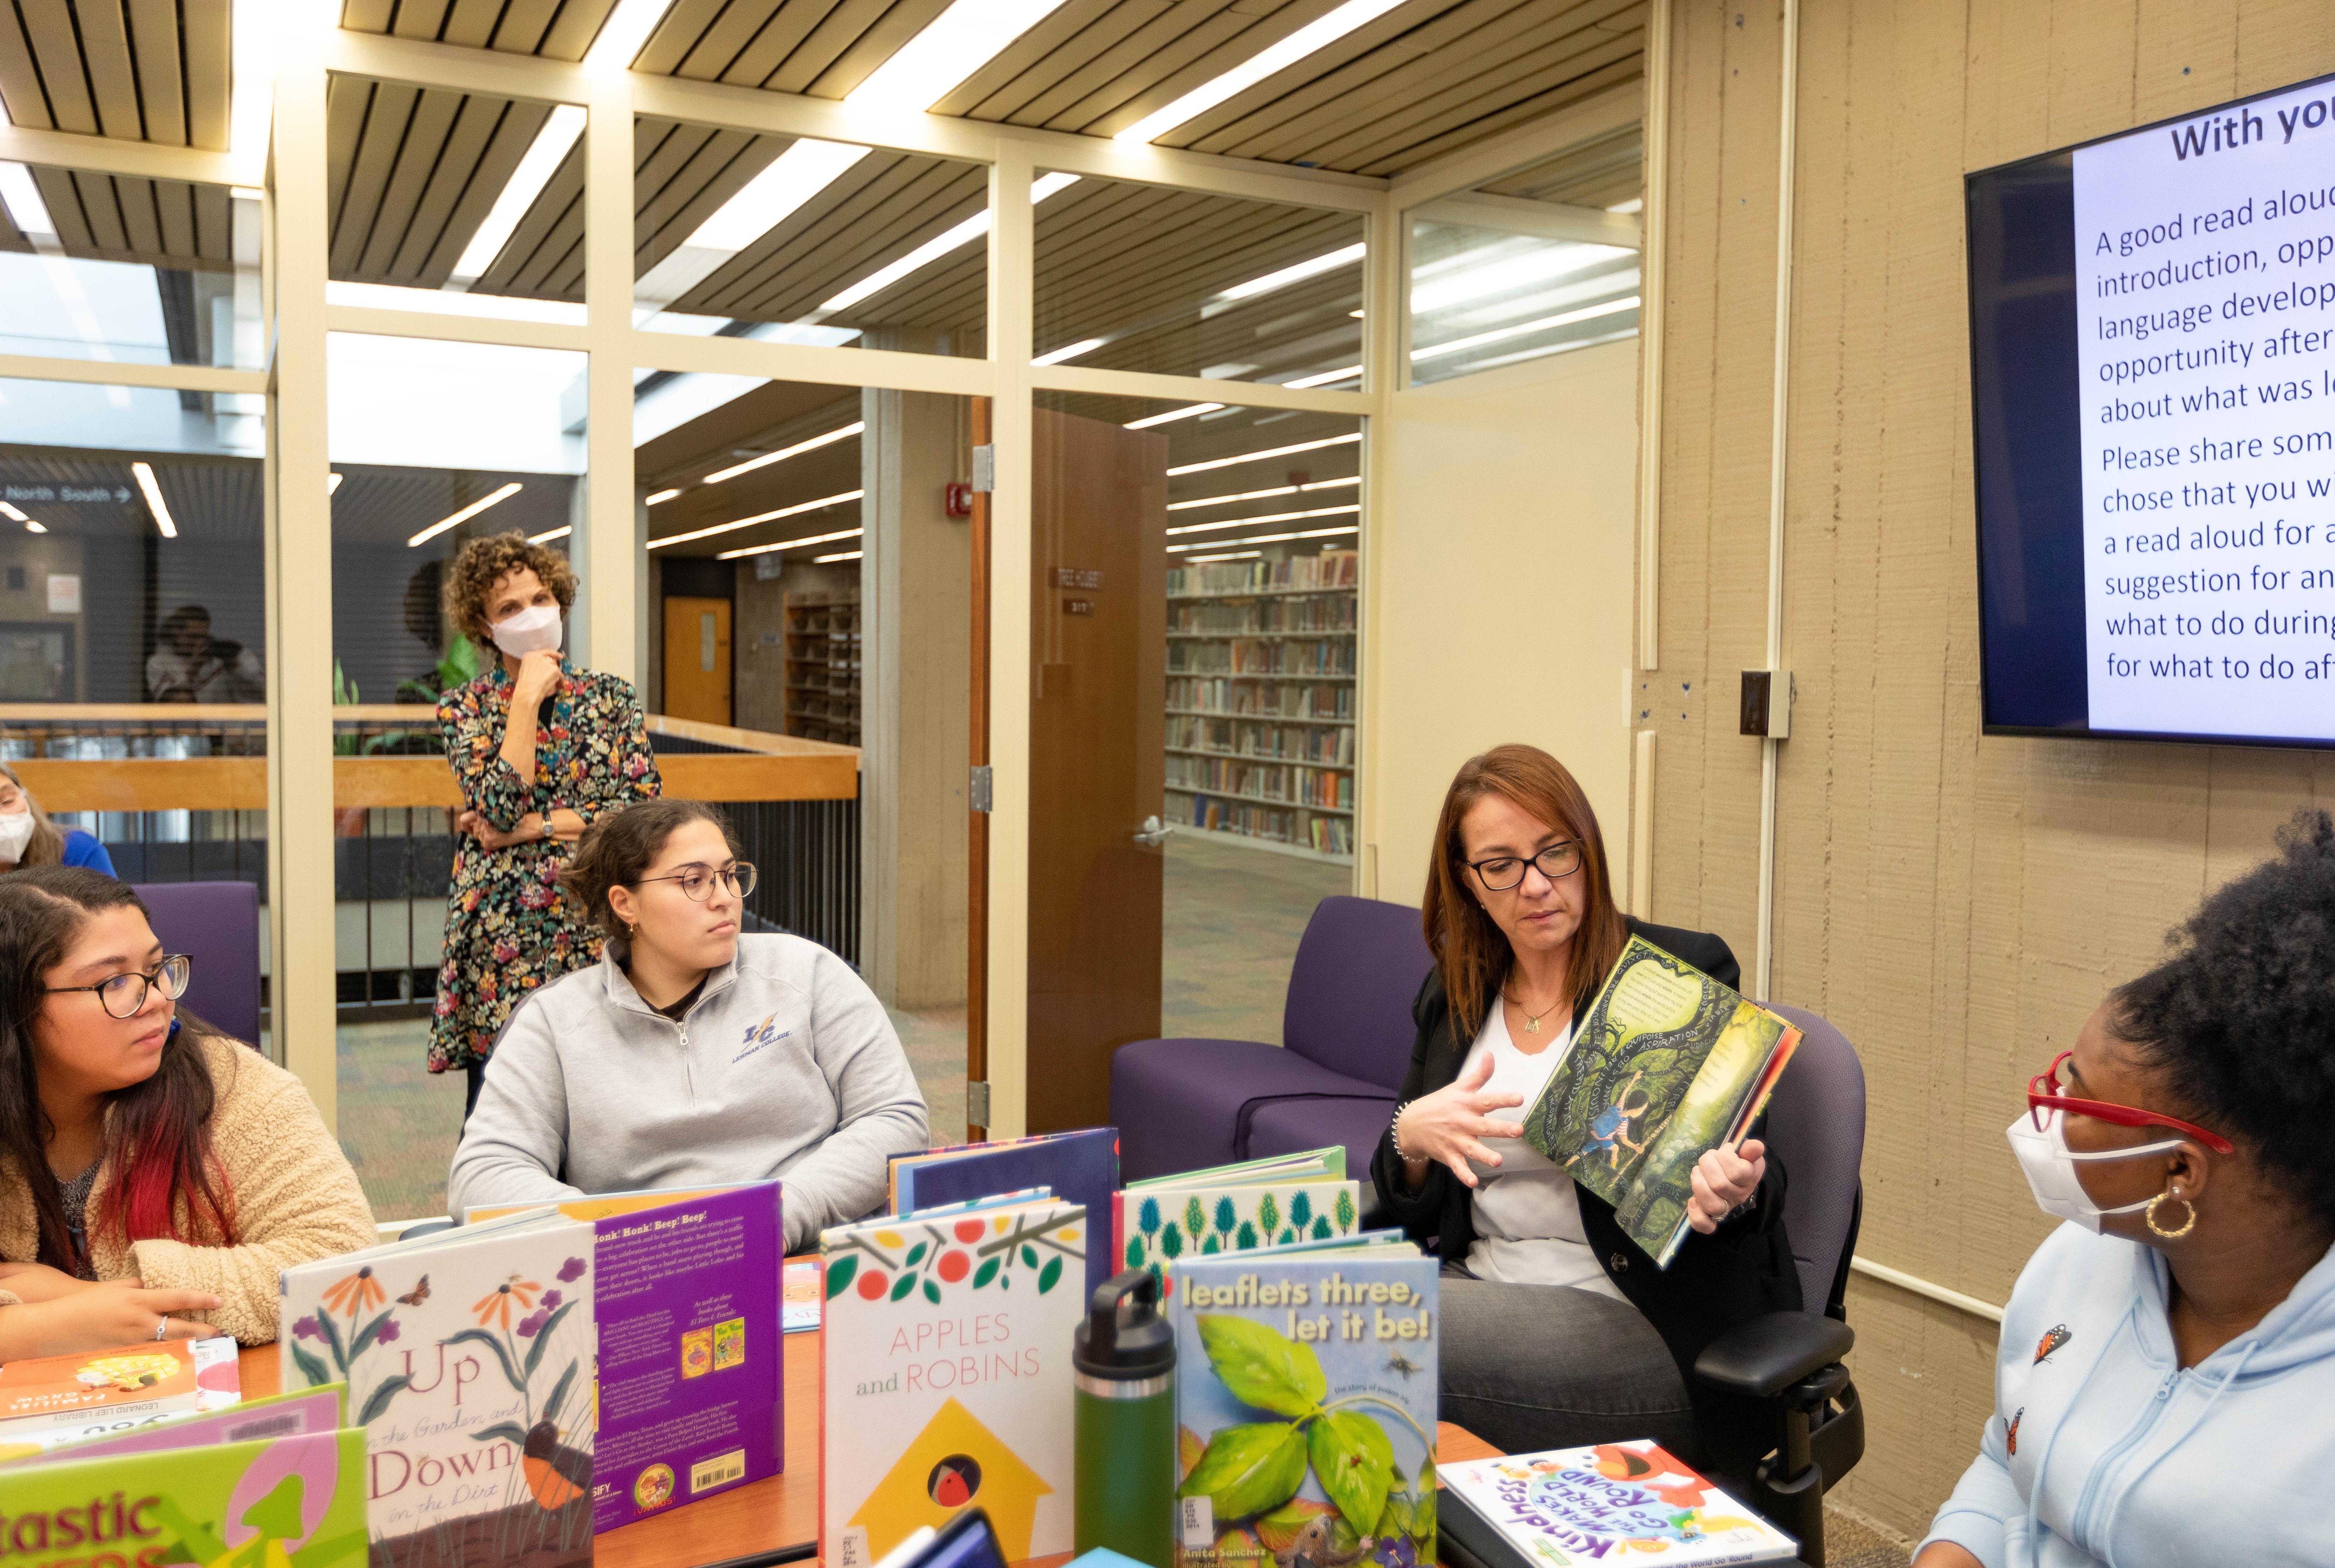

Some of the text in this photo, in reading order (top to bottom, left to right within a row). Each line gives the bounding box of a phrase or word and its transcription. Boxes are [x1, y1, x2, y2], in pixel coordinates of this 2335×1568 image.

[2171, 96, 2335, 161] With yo
[2096, 232, 2112, 255] A
[2120, 214, 2182, 257] good
[2194, 197, 2252, 234] read
[2098, 251, 2266, 298] introduction,
[2099, 304, 2212, 340] language
[2100, 328, 2333, 385] opportunity after
[2101, 394, 2172, 423] about
[2181, 384, 2248, 413] what
[2258, 380, 2312, 404] was
[2103, 432, 2332, 471] Please share som
[61, 486, 111, 502] South
[2103, 489, 2173, 513] chose
[2182, 482, 2235, 507] that
[2245, 481, 2295, 509] you
[2105, 537, 2116, 554] a
[2126, 527, 2180, 552] read
[2190, 521, 2263, 550] aloud
[2274, 519, 2315, 545] for
[2106, 569, 2240, 600] suggestion
[2251, 565, 2290, 590] for
[2106, 612, 2167, 636] what
[2176, 614, 2201, 635] to
[2211, 610, 2244, 635] do
[2108, 653, 2141, 677] for
[2150, 653, 2213, 678] what
[2222, 657, 2249, 679] to
[2260, 654, 2294, 679] do
[1617, 952, 1655, 975] QUIXOTIC
[1655, 972, 1673, 984] overwhelm
[1601, 980, 1619, 1026] PRECARIOUS
[1641, 992, 1652, 1000] whelm
[1662, 985, 1674, 994] whelm.
[1705, 1007, 1729, 1027] VIABLE
[732, 1031, 790, 1064] LEHMAN COLLEGE
[1620, 1033, 1663, 1056] EQUIPOISE
[1638, 1029, 1697, 1053] ASPIRATION
[623, 1223, 652, 1237] Honk!
[654, 1217, 681, 1231] Beep!
[681, 1210, 707, 1224] Beep!
[702, 1297, 713, 1305] well
[714, 1303, 728, 1311] about
[1182, 1272, 1422, 1308] leaflets three,
[889, 1313, 1010, 1356] APPLES
[1287, 1307, 1430, 1341] let it be!
[401, 1343, 481, 1406] Up
[856, 1347, 1040, 1397] and ROBINS
[10, 1393, 106, 1410] FAMILIES
[16, 1392, 78, 1403] GROW
[52, 1402, 159, 1423] LEONARD LIEF LIBRARY
[381, 1425, 408, 1446] the
[415, 1408, 485, 1437] Garden
[491, 1400, 524, 1420] and
[641, 1424, 654, 1433] Texas,
[367, 1442, 516, 1500] Down
[389, 1484, 499, 1523] in the Dirt
[1560, 1471, 1658, 1507] ROUND
[1496, 1478, 1615, 1559] Kindness
[1535, 1495, 1615, 1532] MAKES
[1543, 1481, 1638, 1532] THE WORLD
[0, 1491, 162, 1557] astic
[1184, 1548, 1266, 1558] Anita Sanchez
[1691, 1559, 1712, 1567] World
